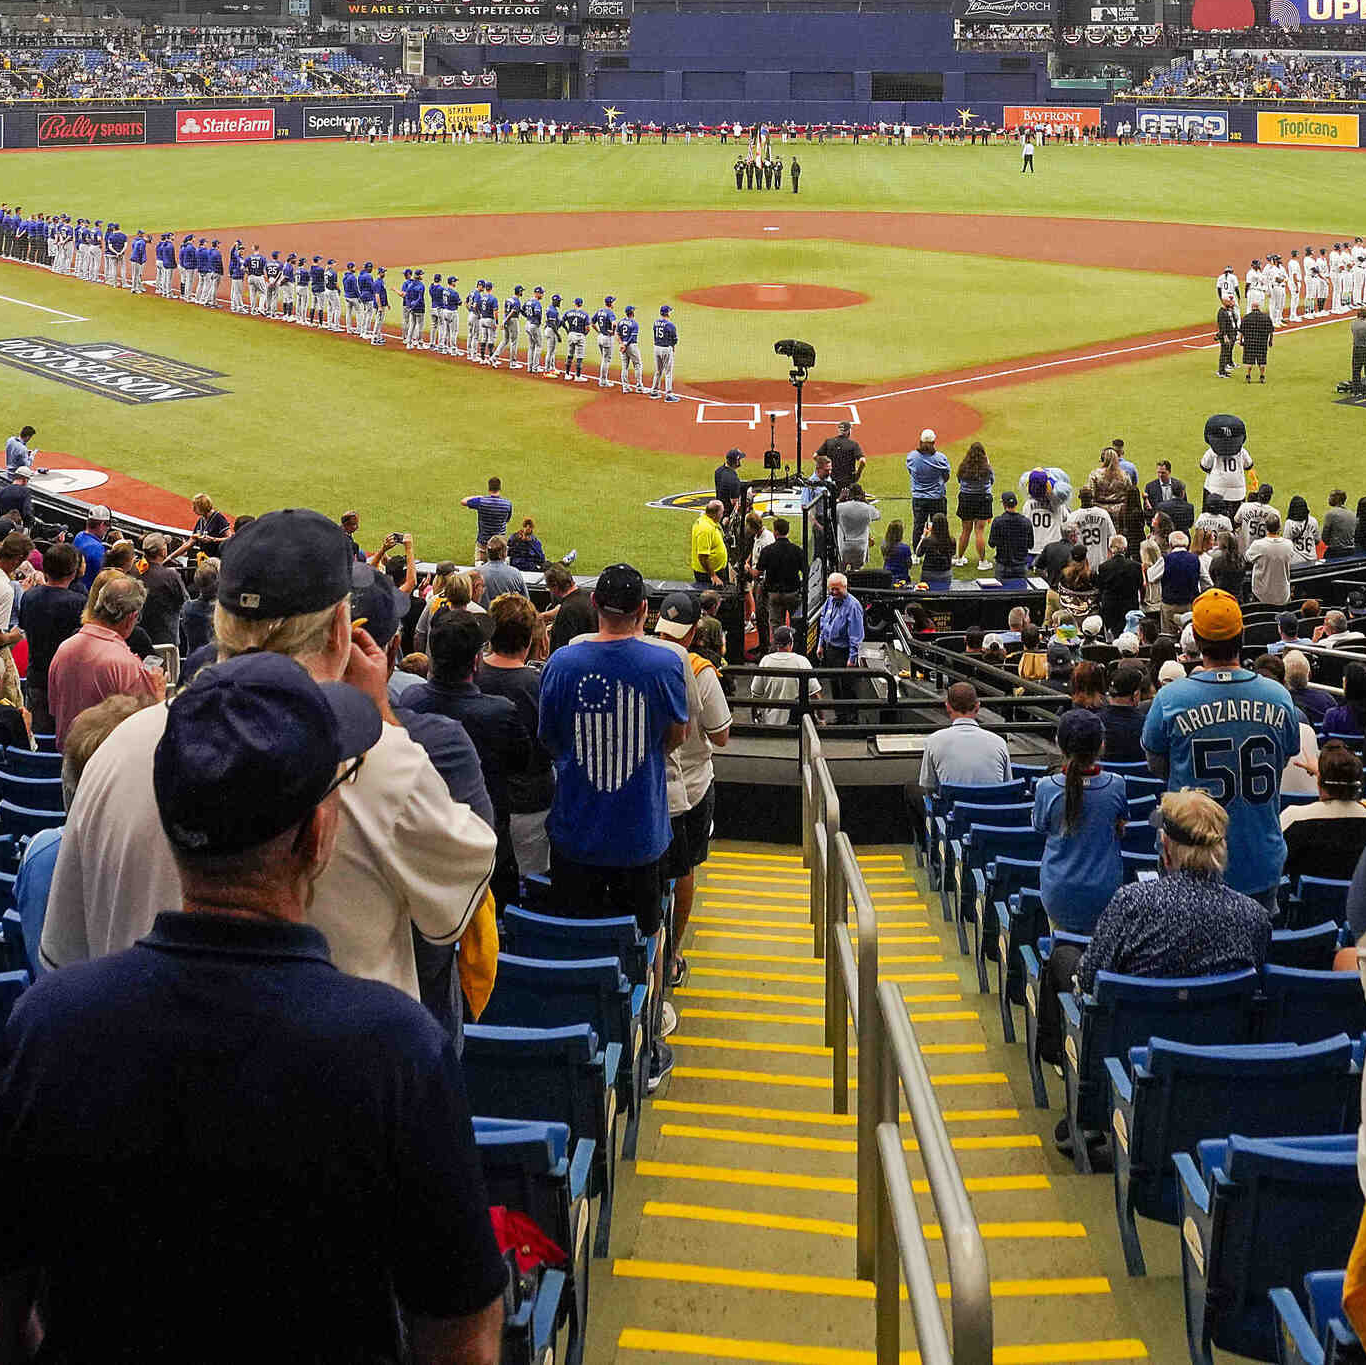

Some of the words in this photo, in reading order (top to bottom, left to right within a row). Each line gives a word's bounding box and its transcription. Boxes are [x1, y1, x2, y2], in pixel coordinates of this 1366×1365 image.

[348, 5, 368, 14] WE
[371, 5, 394, 14] ARE
[469, 6, 540, 15] STPETE.ORG
[588, 6, 624, 15] PORCH
[1015, 1, 1051, 11] PORCH
[1023, 109, 1083, 123] BAYFRONT
[40, 115, 102, 141] Bally
[100, 122, 144, 137] SPORTS
[1139, 114, 1226, 135] GEICO
[1277, 118, 1338, 139] Tropicana
[250, 260, 260, 269] 51
[267, 266, 278, 275] 25
[572, 318, 578, 327] 4
[655, 327, 664, 338] 15
[1223, 458, 1237, 472] 10
[1032, 512, 1051, 529] 00
